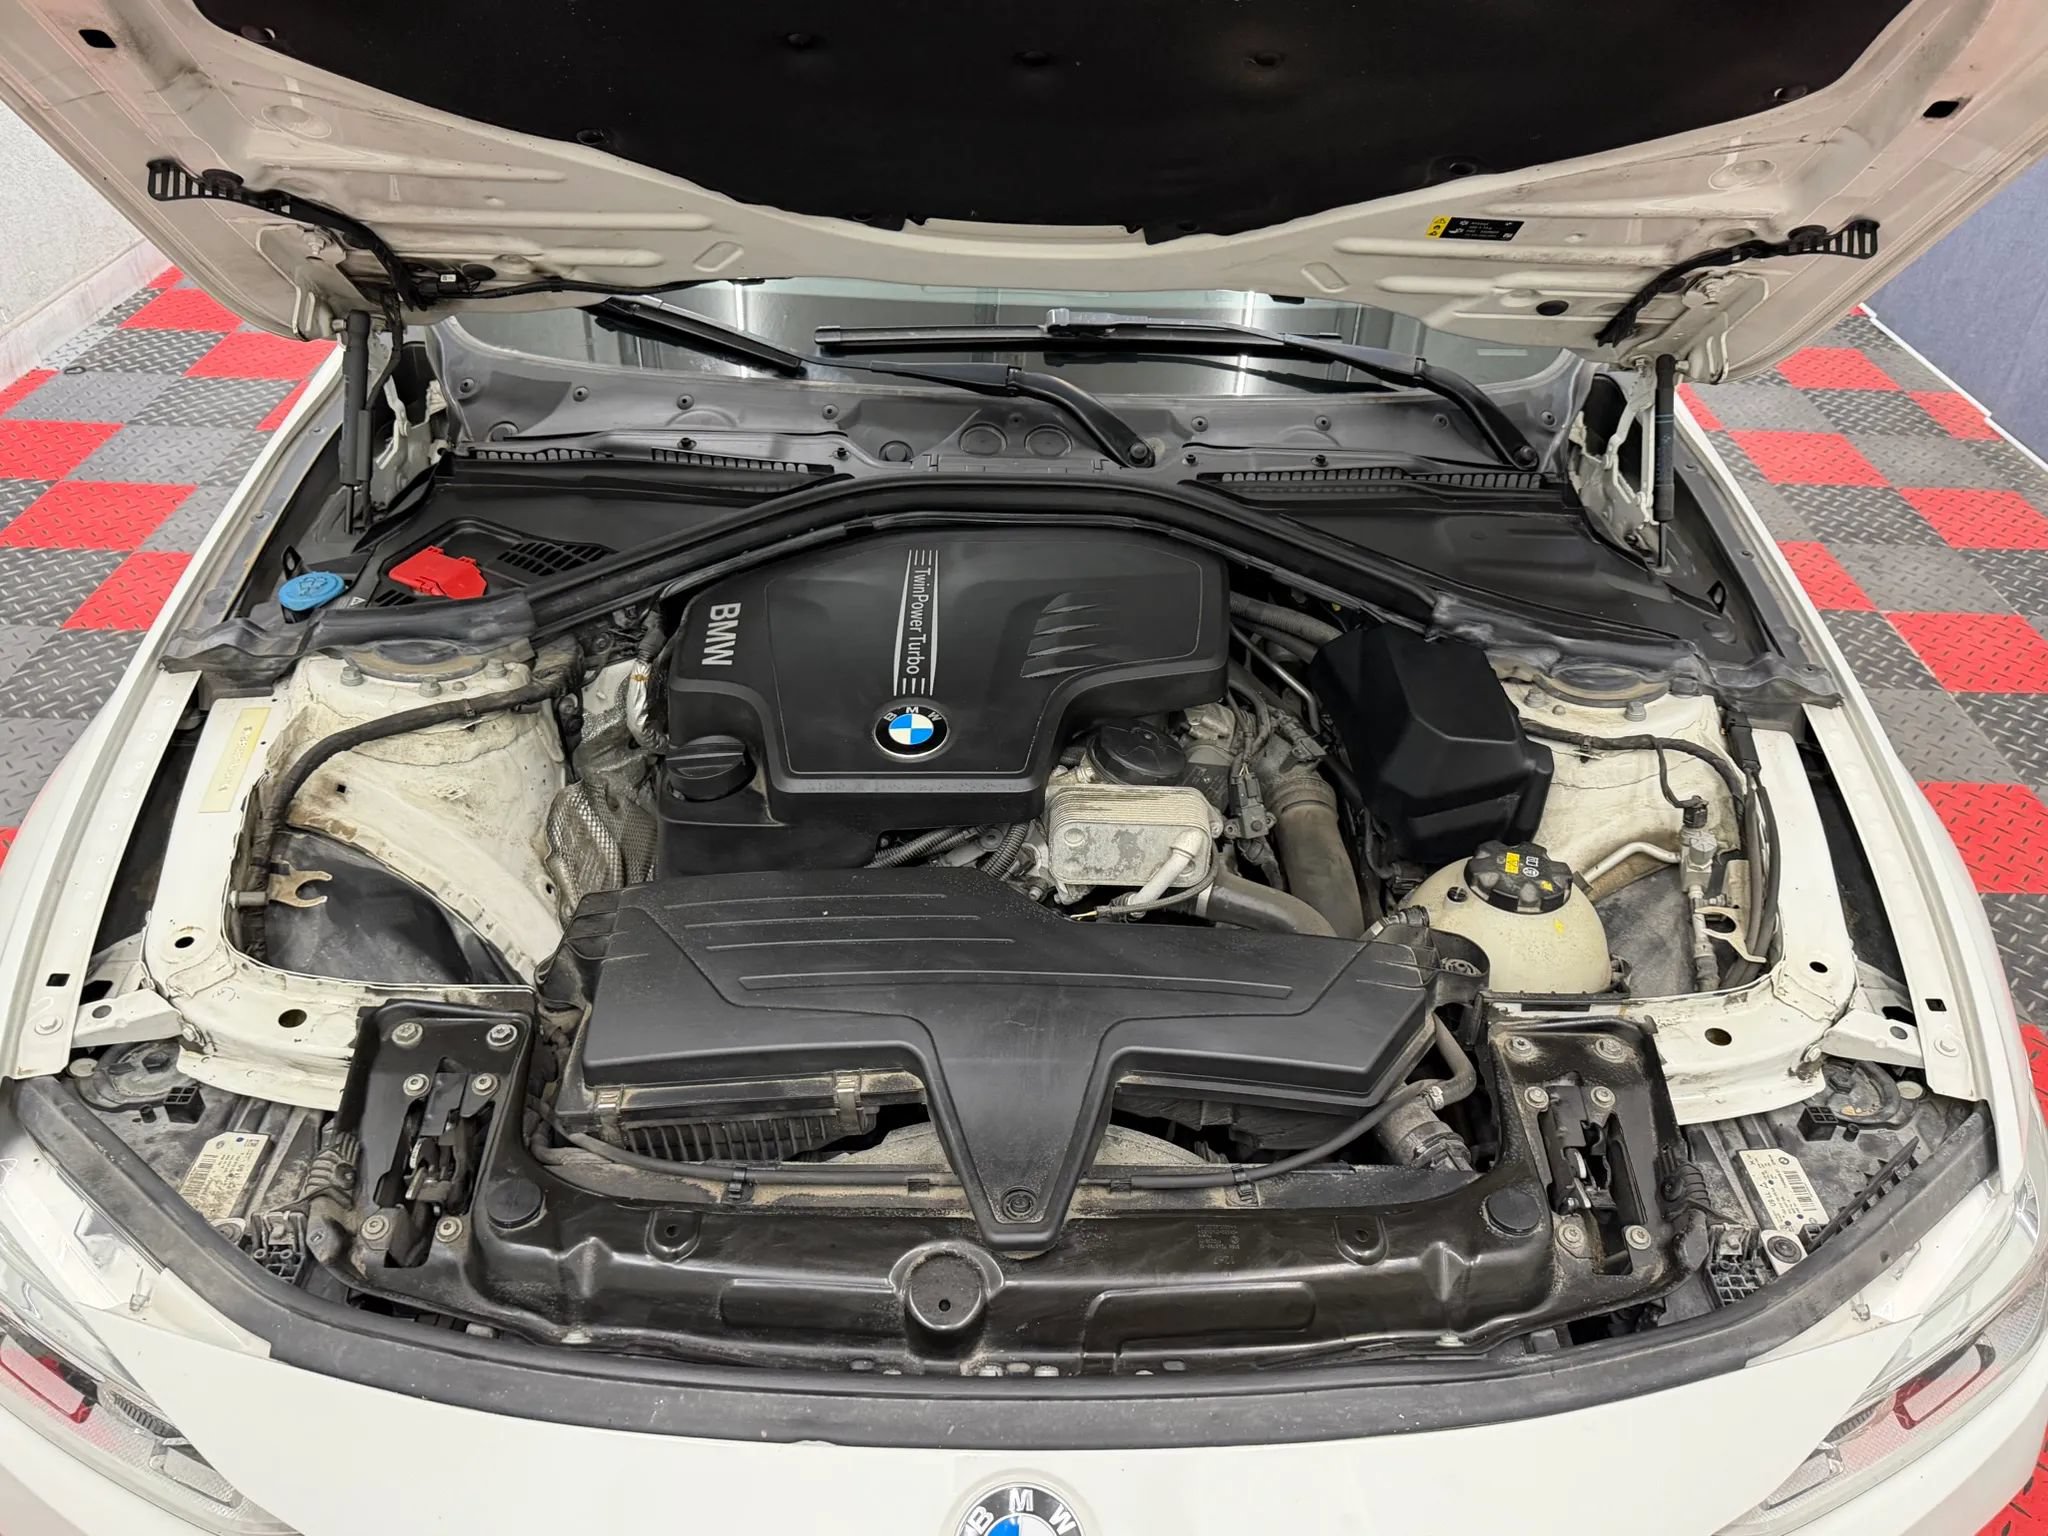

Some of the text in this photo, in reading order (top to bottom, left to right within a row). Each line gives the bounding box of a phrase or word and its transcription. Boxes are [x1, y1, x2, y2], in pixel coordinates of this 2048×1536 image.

[702, 603, 741, 665] BMW
[906, 567, 931, 675] TwinPower Turbo
[883, 706, 942, 722] BMW
[967, 1488, 1077, 1536] BMW
